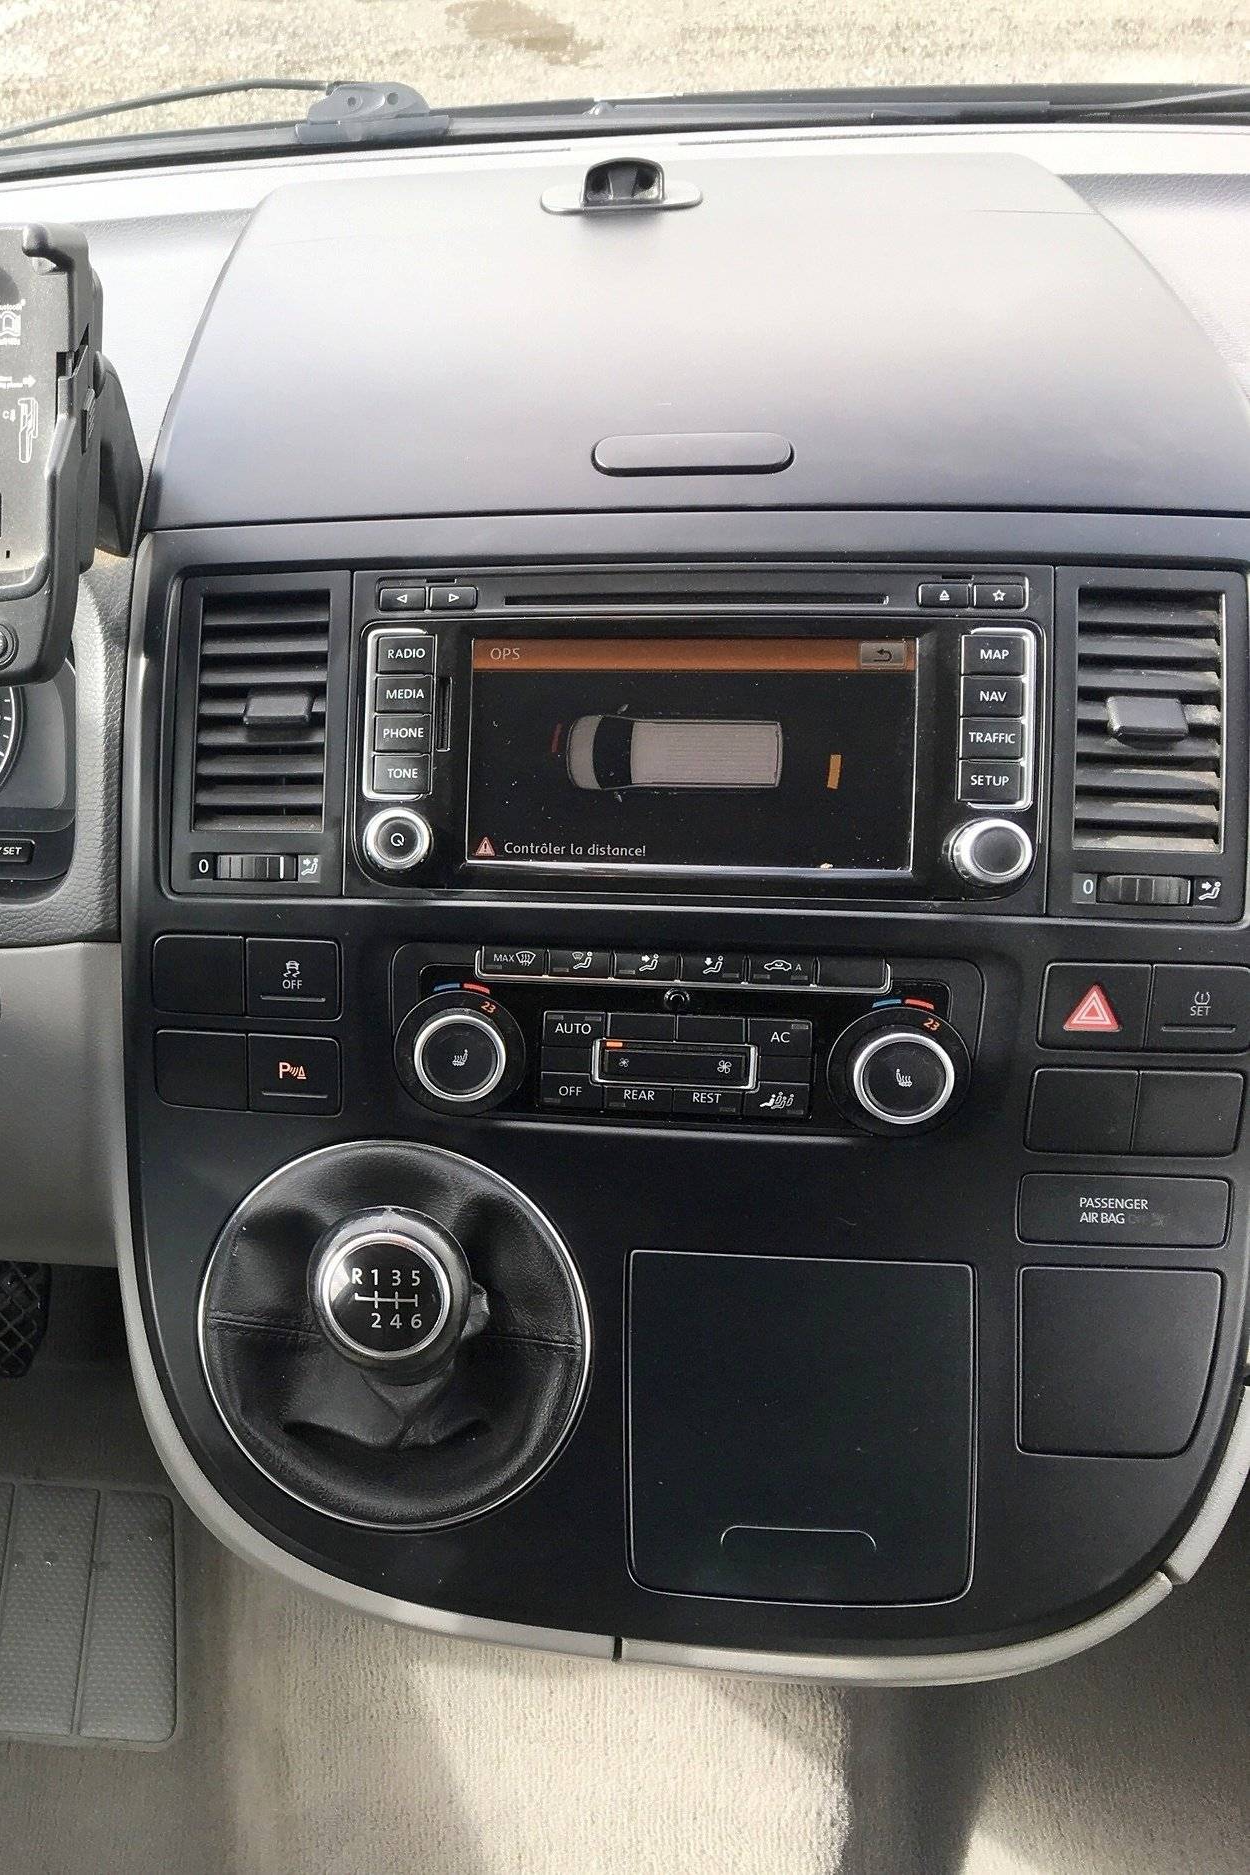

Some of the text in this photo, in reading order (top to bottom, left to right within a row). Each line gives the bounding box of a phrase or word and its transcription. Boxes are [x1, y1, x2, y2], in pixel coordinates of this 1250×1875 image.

[387, 648, 426, 659] RADIO
[490, 648, 521, 661] OPS
[980, 649, 1010, 660] MAP
[386, 688, 425, 700] MEDIA
[979, 690, 1007, 702] NAV
[382, 727, 424, 739] PHONE
[968, 732, 1016, 744] TRAFFIC
[387, 768, 418, 779] TONE
[970, 774, 1010, 787] SETUP
[504, 842, 646, 857] Contrôler la distance!
[198, 859, 209, 874] 0
[1082, 880, 1094, 895] 0
[493, 953, 515, 963] MAX
[795, 963, 802, 972] A
[282, 980, 303, 990] OFF
[480, 1000, 496, 1014] 23
[1190, 1005, 1211, 1017] SET
[554, 1023, 592, 1035] AUTO
[922, 1018, 941, 1032] 23
[770, 1031, 791, 1044] AC
[558, 1086, 582, 1096] OFF
[623, 1089, 655, 1101] REAR
[692, 1093, 722, 1104] REST
[1080, 1197, 1148, 1210] PASSENGER
[1080, 1212, 1099, 1224] AIR
[1100, 1212, 1126, 1224] BAG
[352, 1268, 420, 1286] R 1 3 5
[371, 1312, 422, 1328] 2 4 6
